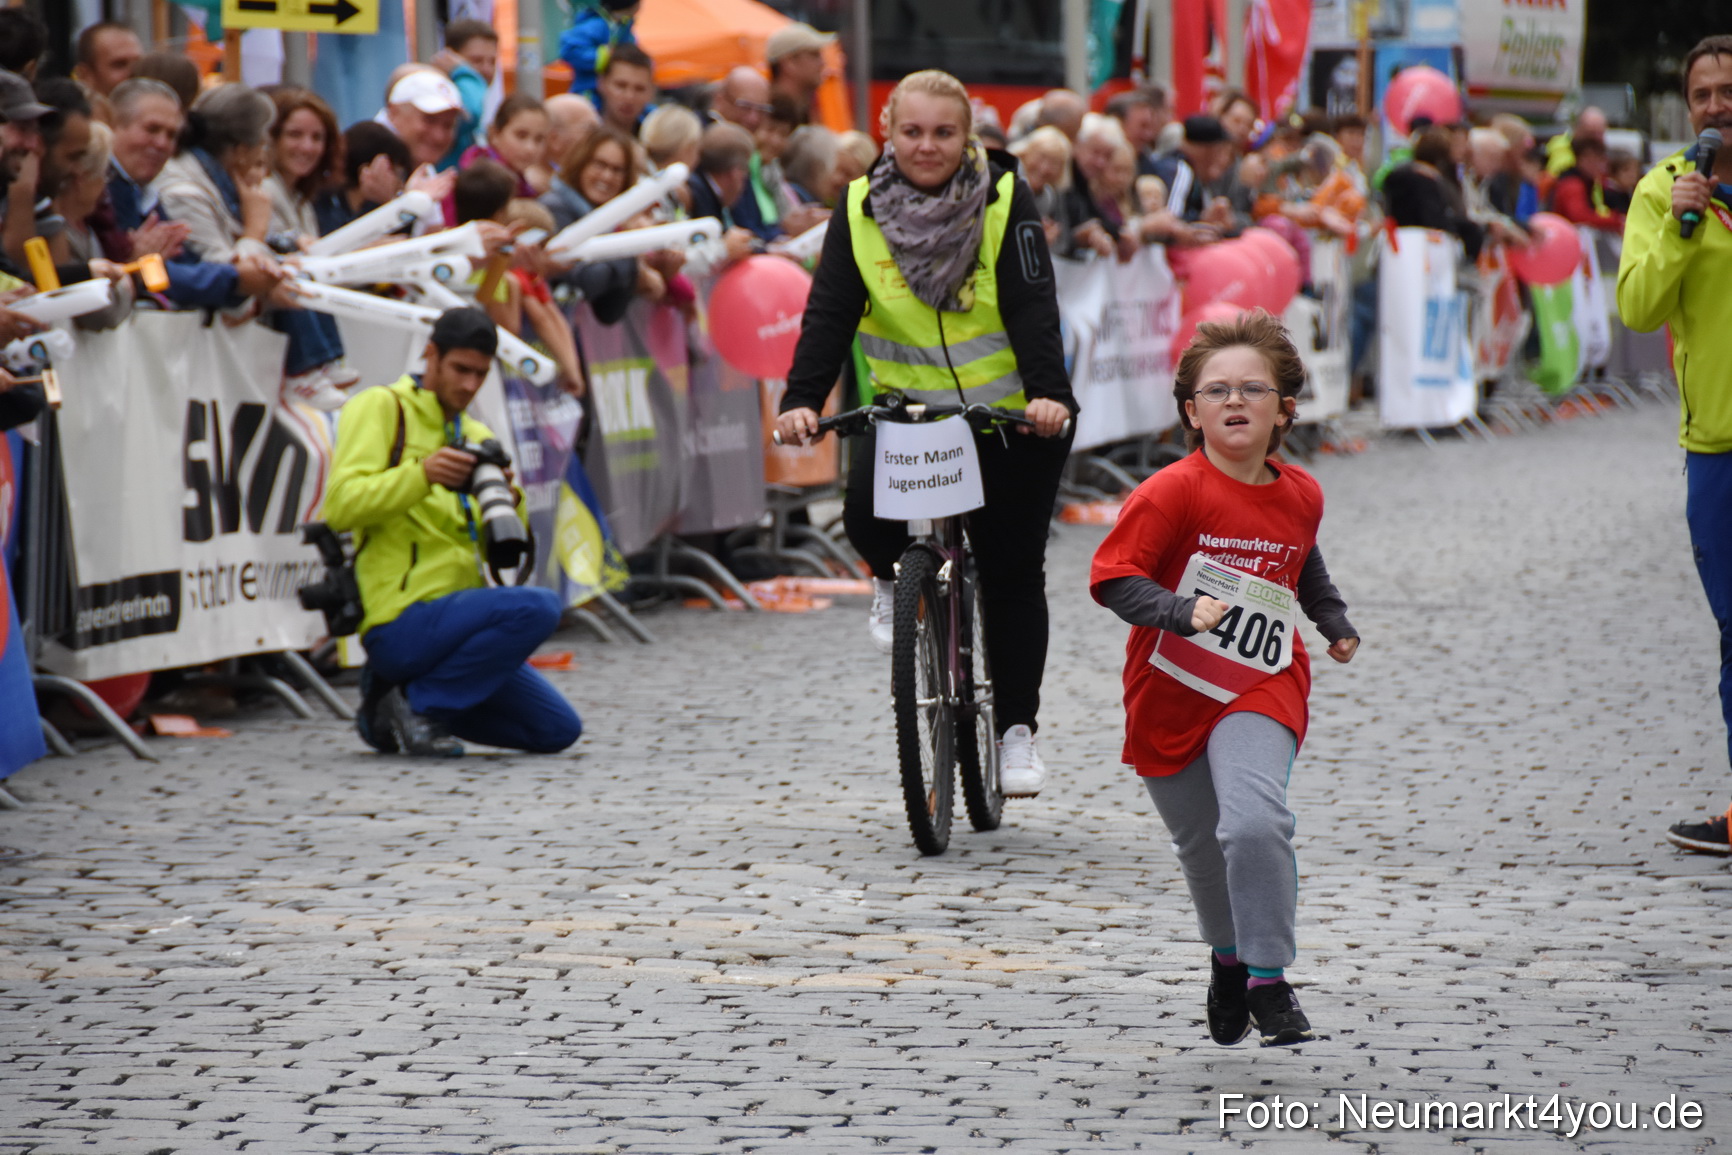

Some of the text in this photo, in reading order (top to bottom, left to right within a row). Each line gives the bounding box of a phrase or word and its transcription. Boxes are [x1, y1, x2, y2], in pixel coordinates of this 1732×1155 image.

[884, 446, 964, 466] Erster Mann
[887, 468, 963, 493] Jugendlauf
[1198, 533, 1284, 554] Neumarkter
[1196, 570, 1239, 594] NeuerMarkt
[1246, 580, 1291, 610] BOCK
